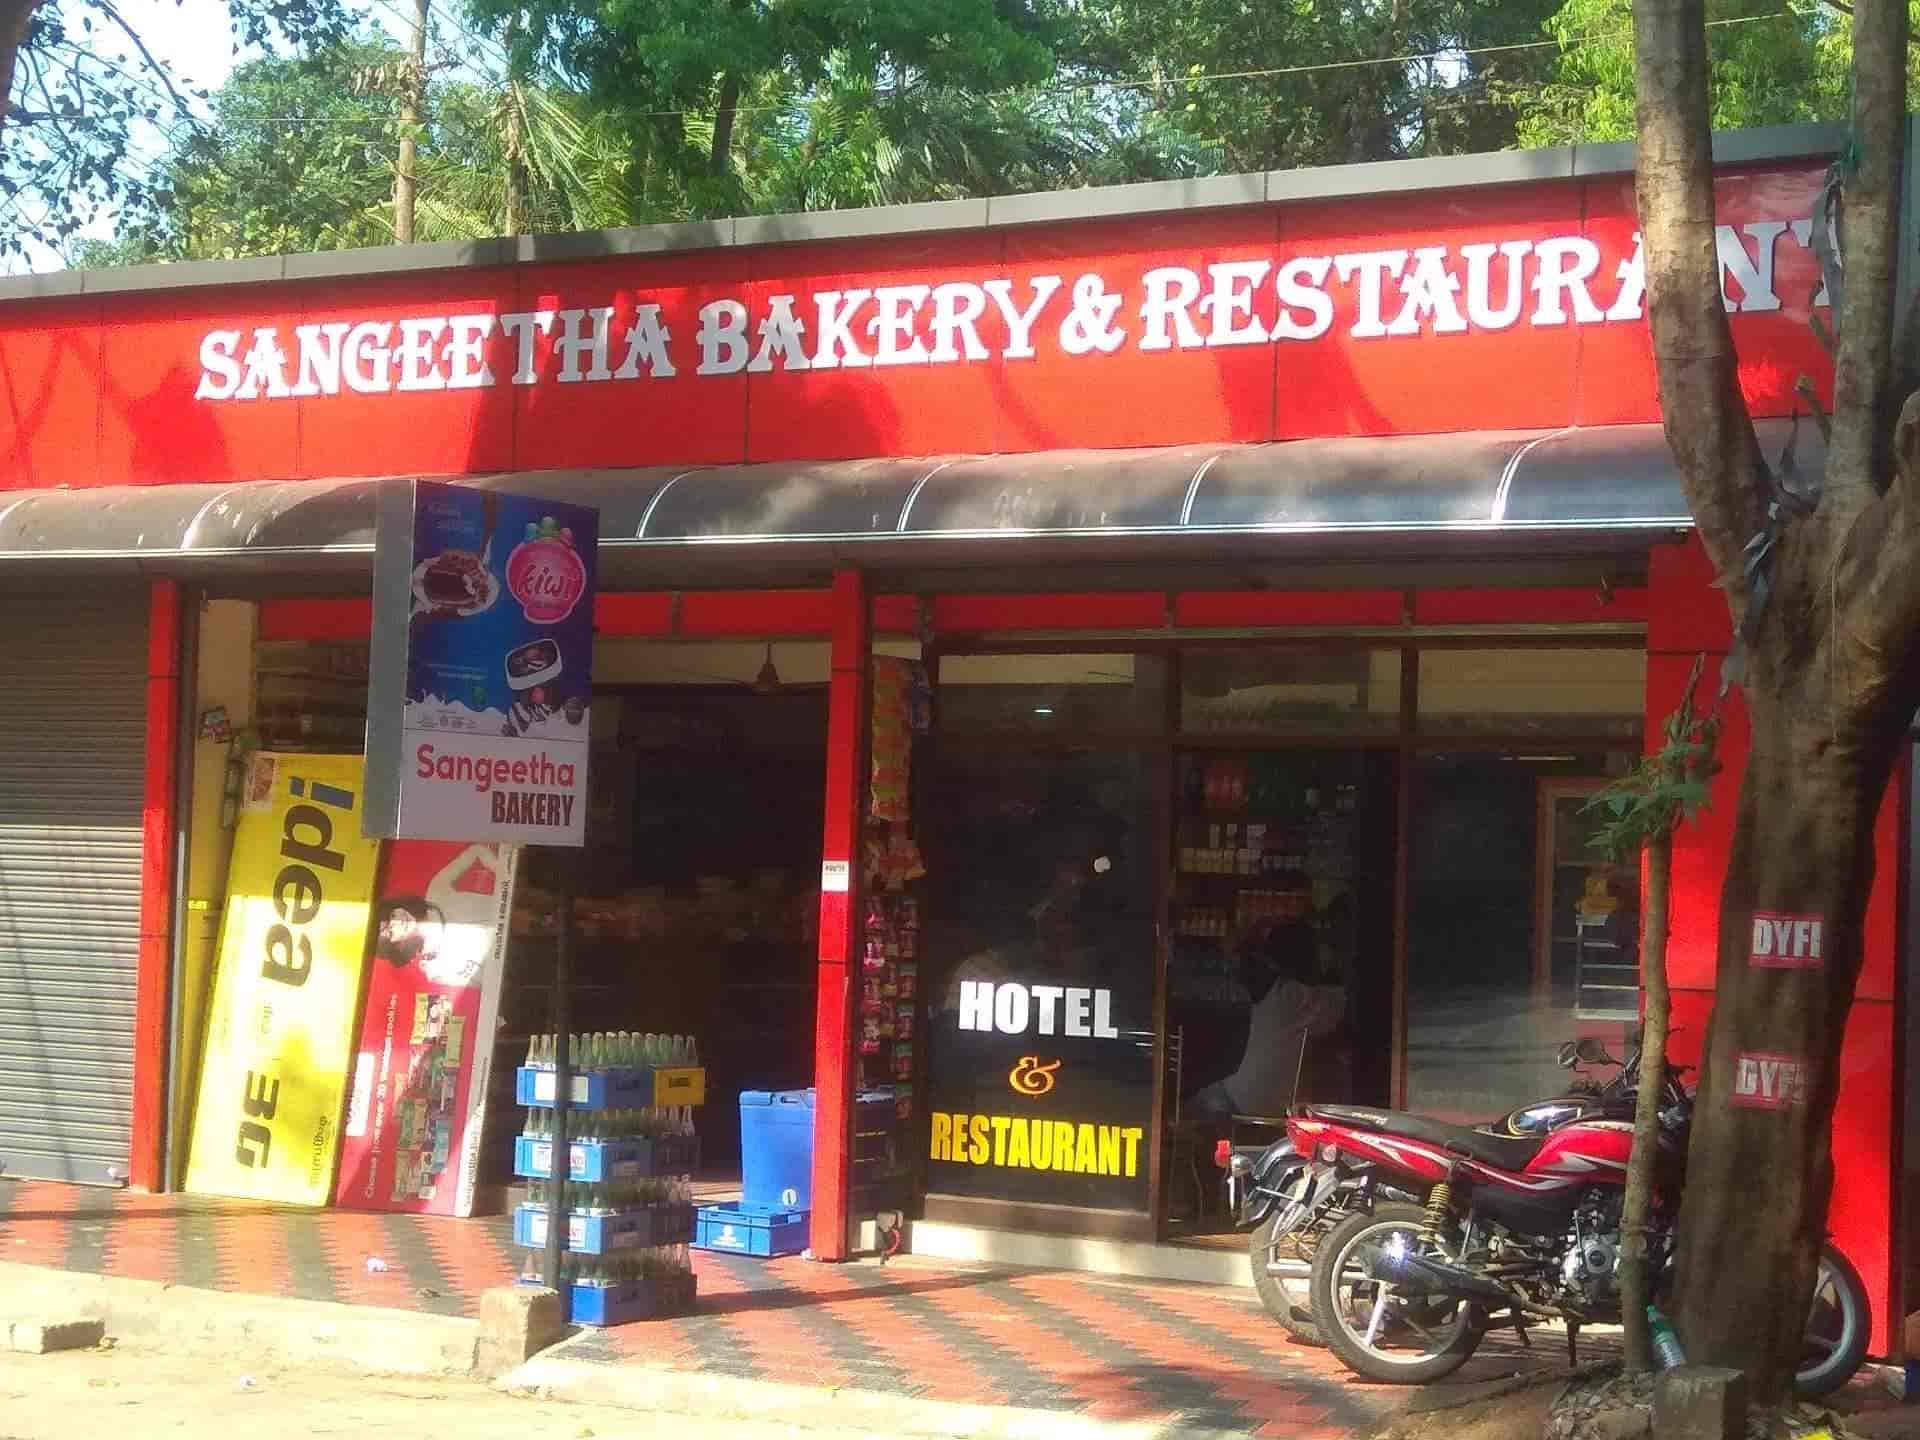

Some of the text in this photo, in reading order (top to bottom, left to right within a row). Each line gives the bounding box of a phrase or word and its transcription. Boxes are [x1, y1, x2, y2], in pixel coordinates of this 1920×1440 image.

[195, 302, 676, 401] SANGEETHA
[696, 275, 1062, 375] BAKERY
[1060, 272, 1127, 355] &
[416, 743, 575, 792] Sangeetha
[491, 790, 574, 826] BAKERY
[957, 980, 1119, 1039] HOTEL
[1009, 1056, 1062, 1095] &
[235, 1068, 281, 1169] 3G
[930, 1111, 1142, 1177] RESTAURANT
